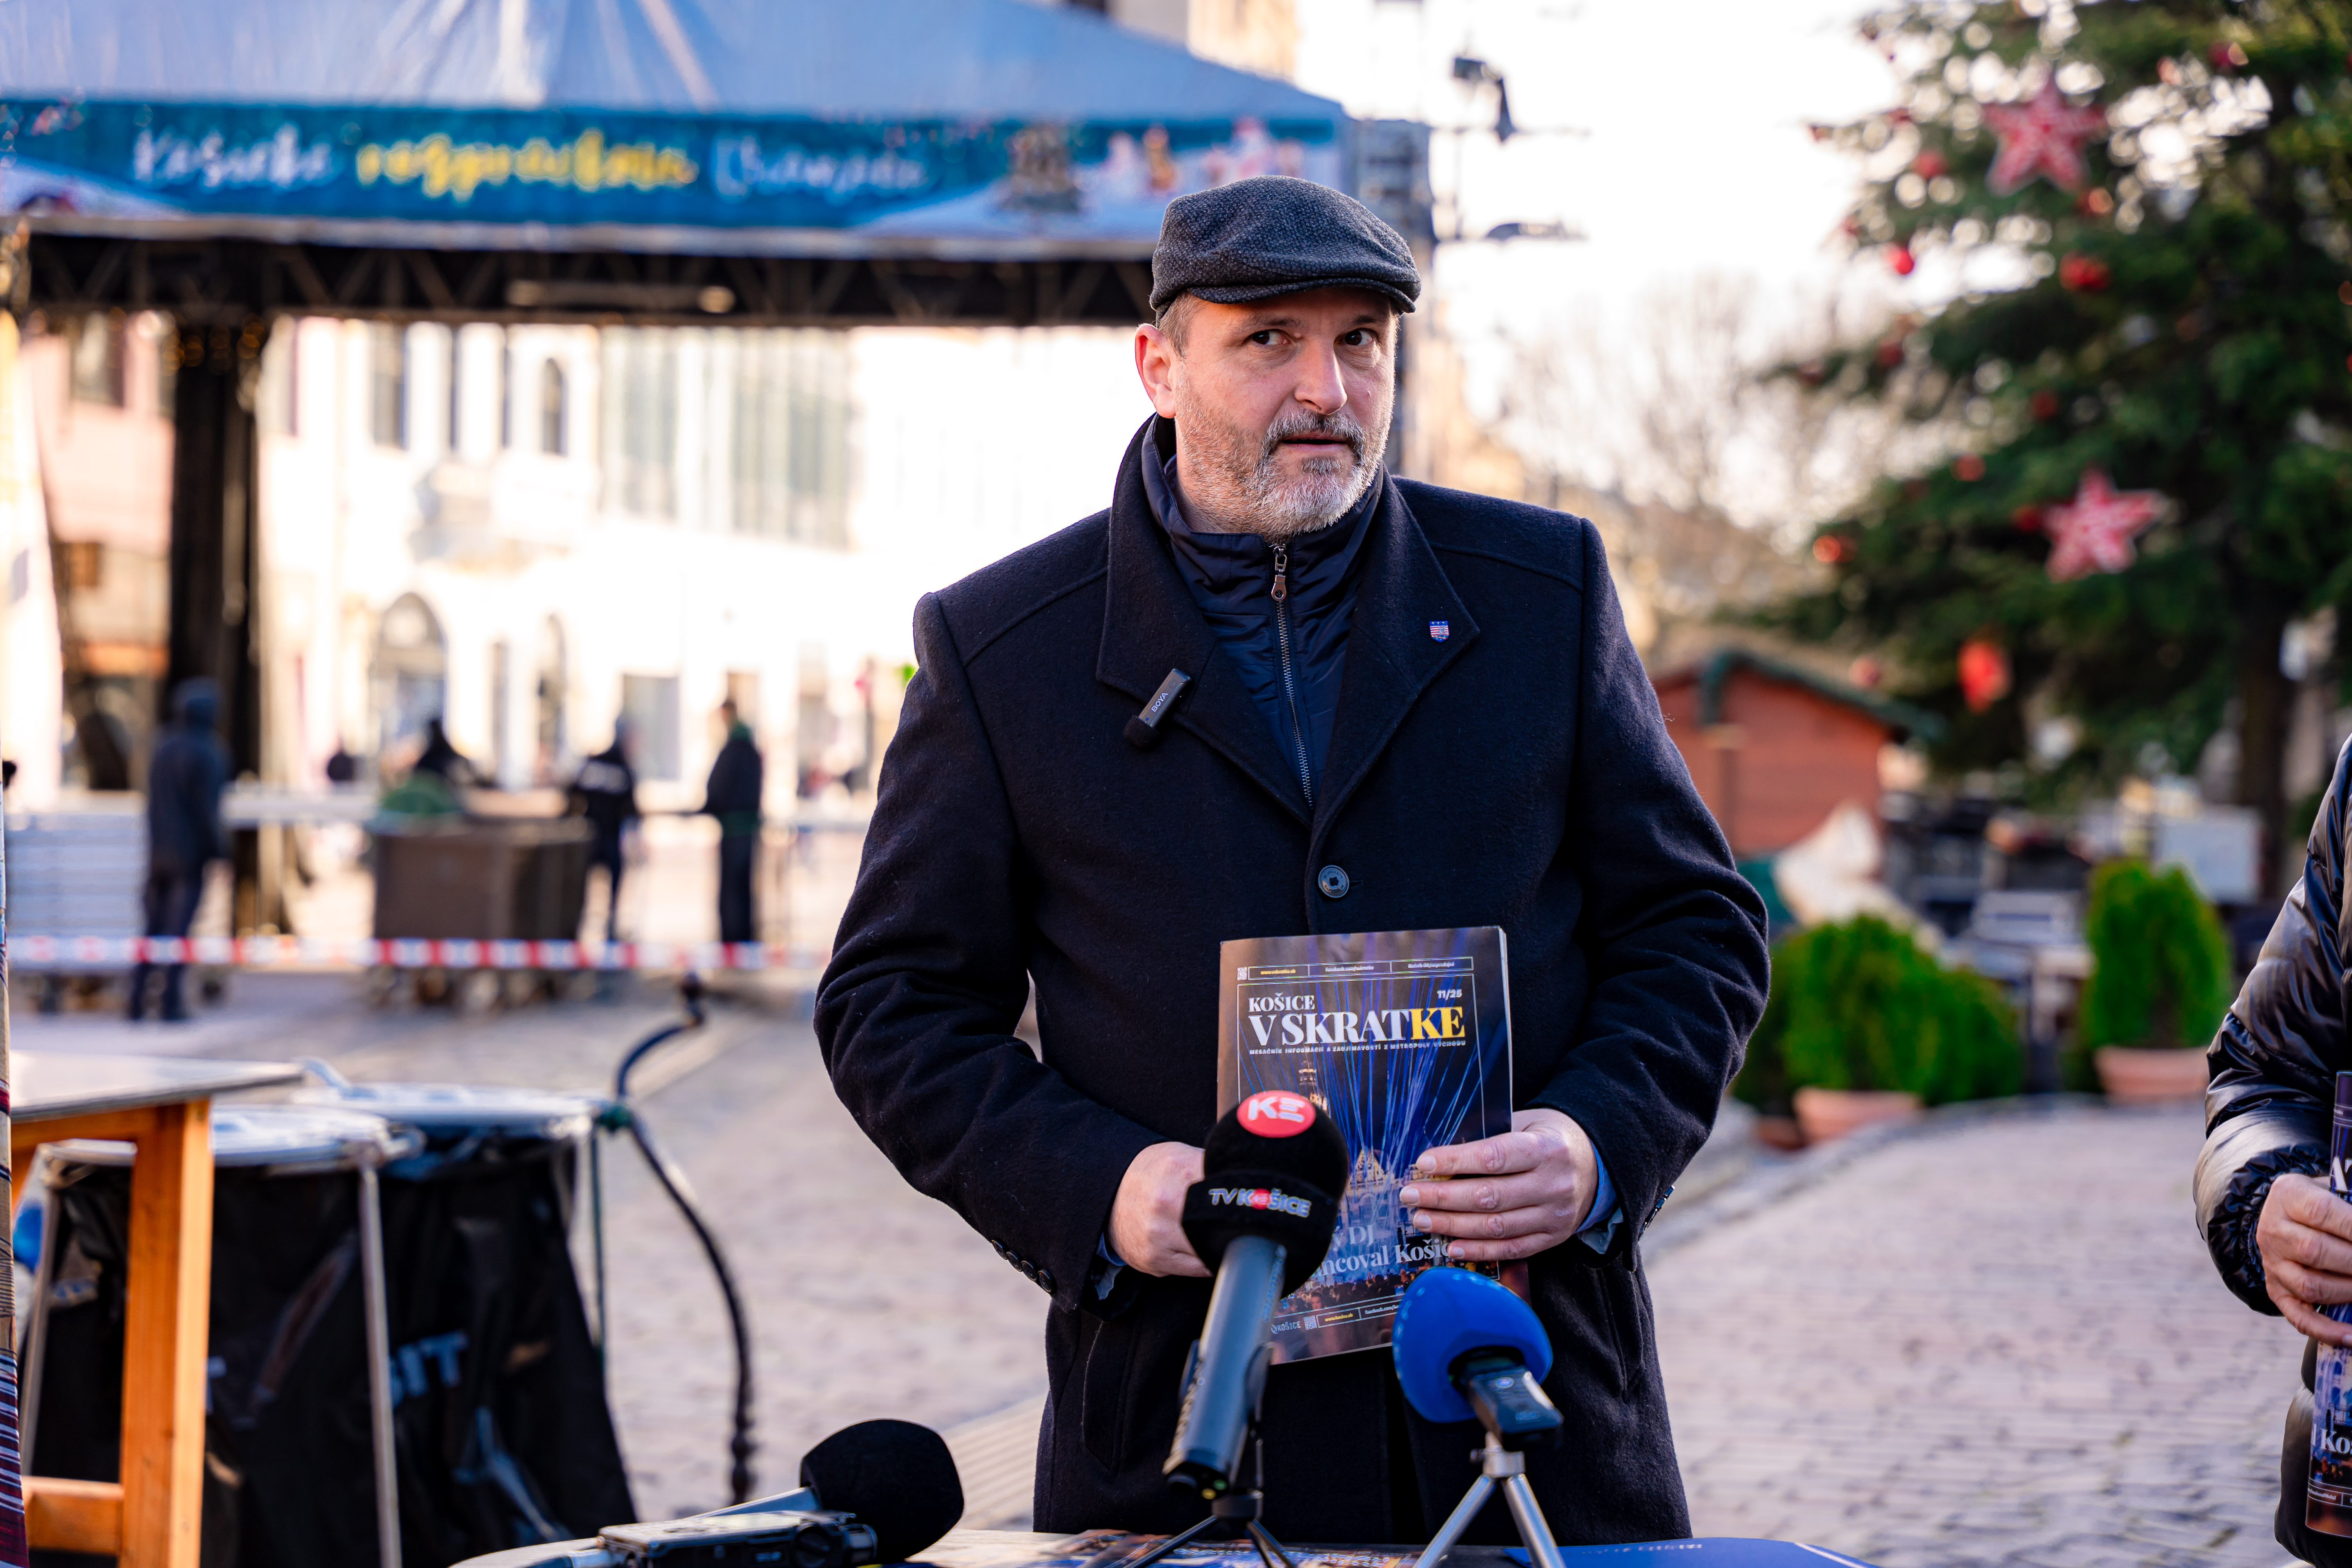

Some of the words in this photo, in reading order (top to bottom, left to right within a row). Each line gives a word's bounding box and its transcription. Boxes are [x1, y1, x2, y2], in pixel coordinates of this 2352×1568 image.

[1151, 693, 1168, 712] BOYA
[1248, 992, 1315, 1012] KOŠICE
[1437, 989, 1462, 1000] 11/25
[1281, 1006, 1465, 1045] SKRATKE
[1248, 1096, 1305, 1123] KE
[1209, 1188, 1238, 1205] TV
[1347, 1223, 1374, 1247] DJ
[1317, 1245, 1390, 1276] ncoval
[1394, 1238, 1448, 1264] Košic
[1277, 1321, 1301, 1331] KOŠICE
